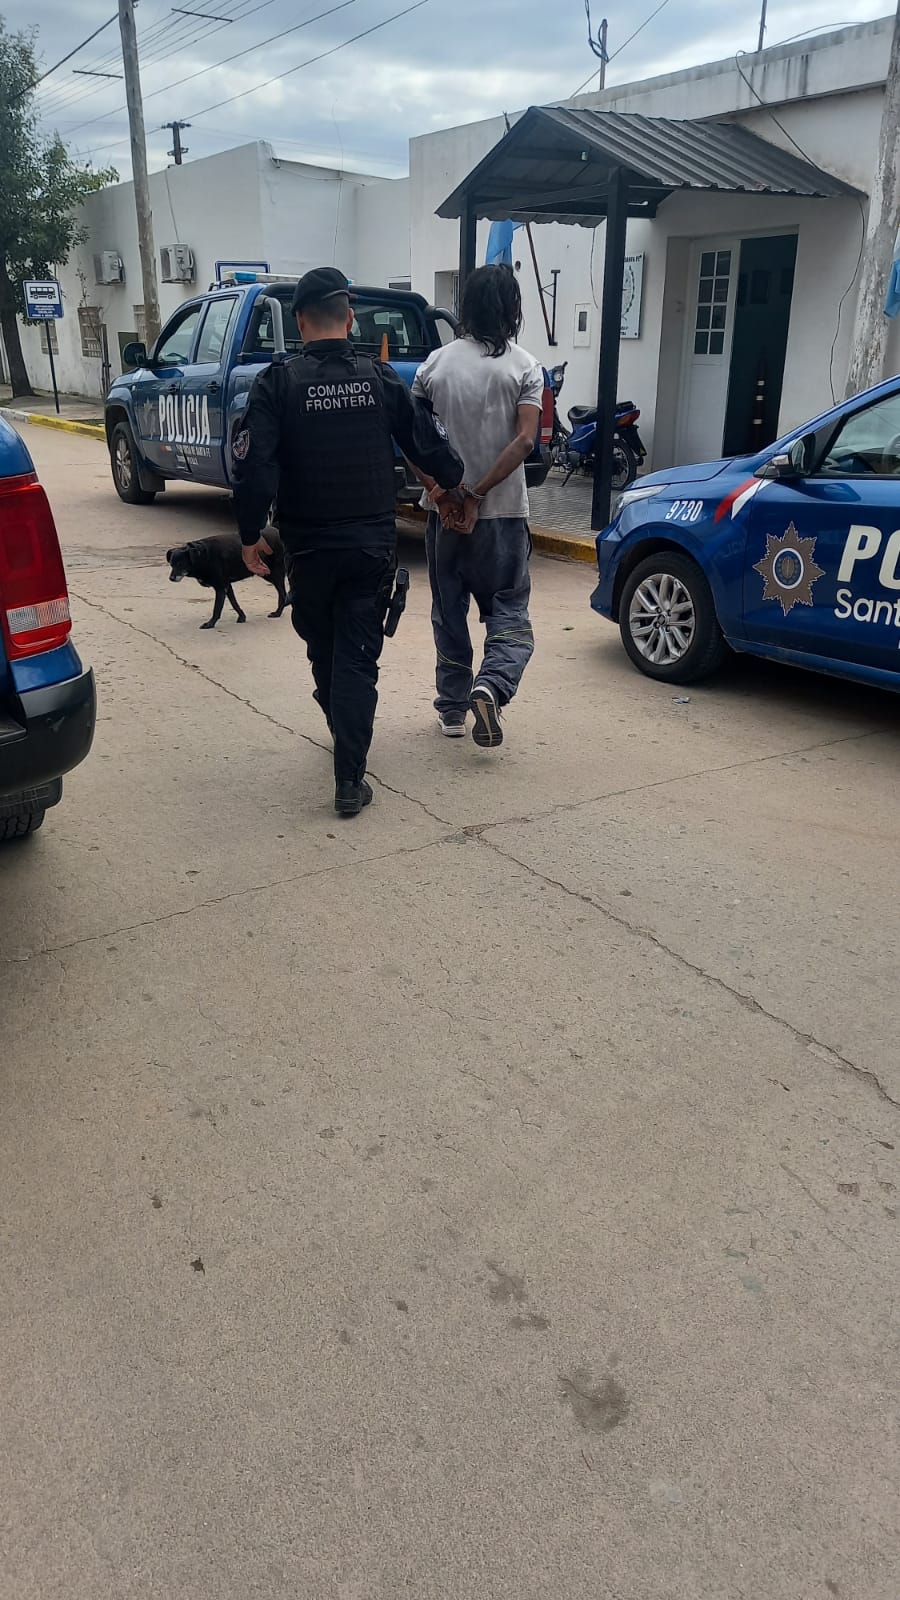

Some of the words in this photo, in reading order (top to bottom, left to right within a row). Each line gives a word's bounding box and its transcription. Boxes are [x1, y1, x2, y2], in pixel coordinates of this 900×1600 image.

[307, 381, 371, 398] COMANDO
[305, 394, 376, 412] FRONTERA
[158, 393, 211, 445] POLICIA
[665, 500, 704, 522] 9730
